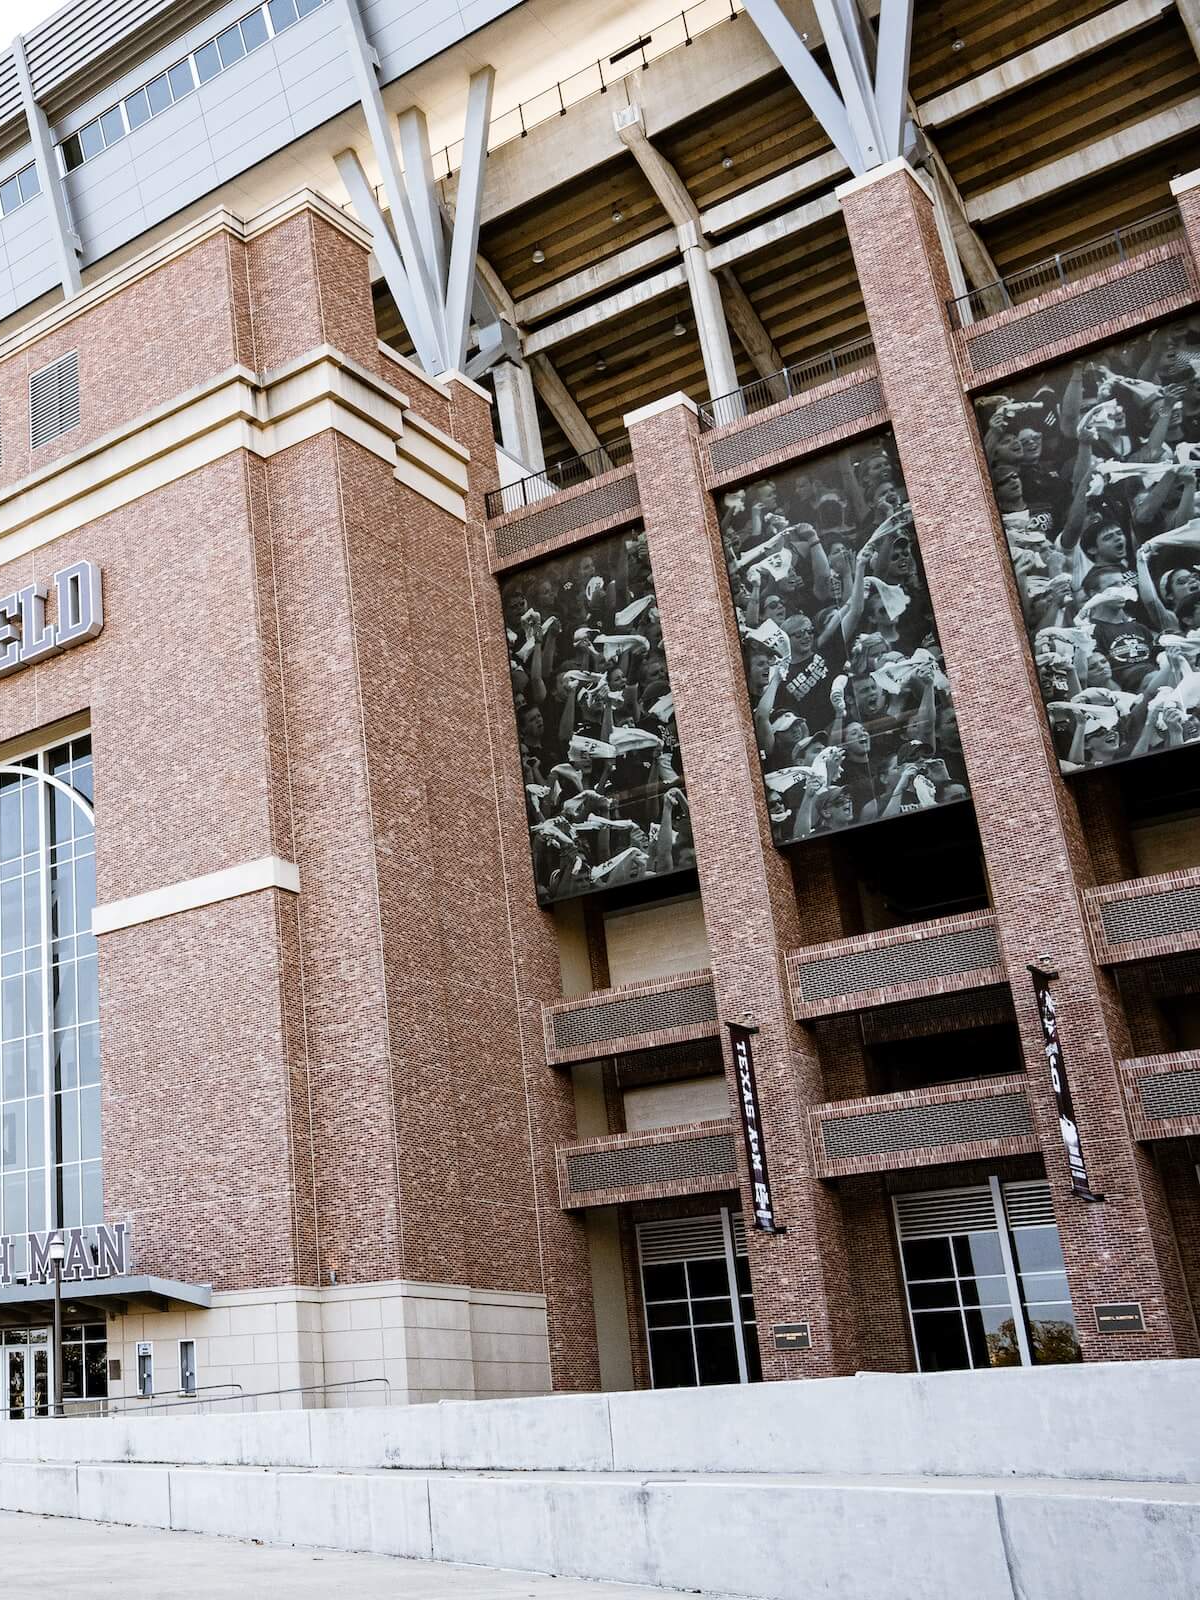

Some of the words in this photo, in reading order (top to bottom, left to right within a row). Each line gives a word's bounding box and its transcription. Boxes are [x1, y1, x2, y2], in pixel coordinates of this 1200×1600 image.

[736, 1041, 756, 1120] TEXAS
[748, 1124, 762, 1171] A&M
[28, 1222, 128, 1284] MAN
